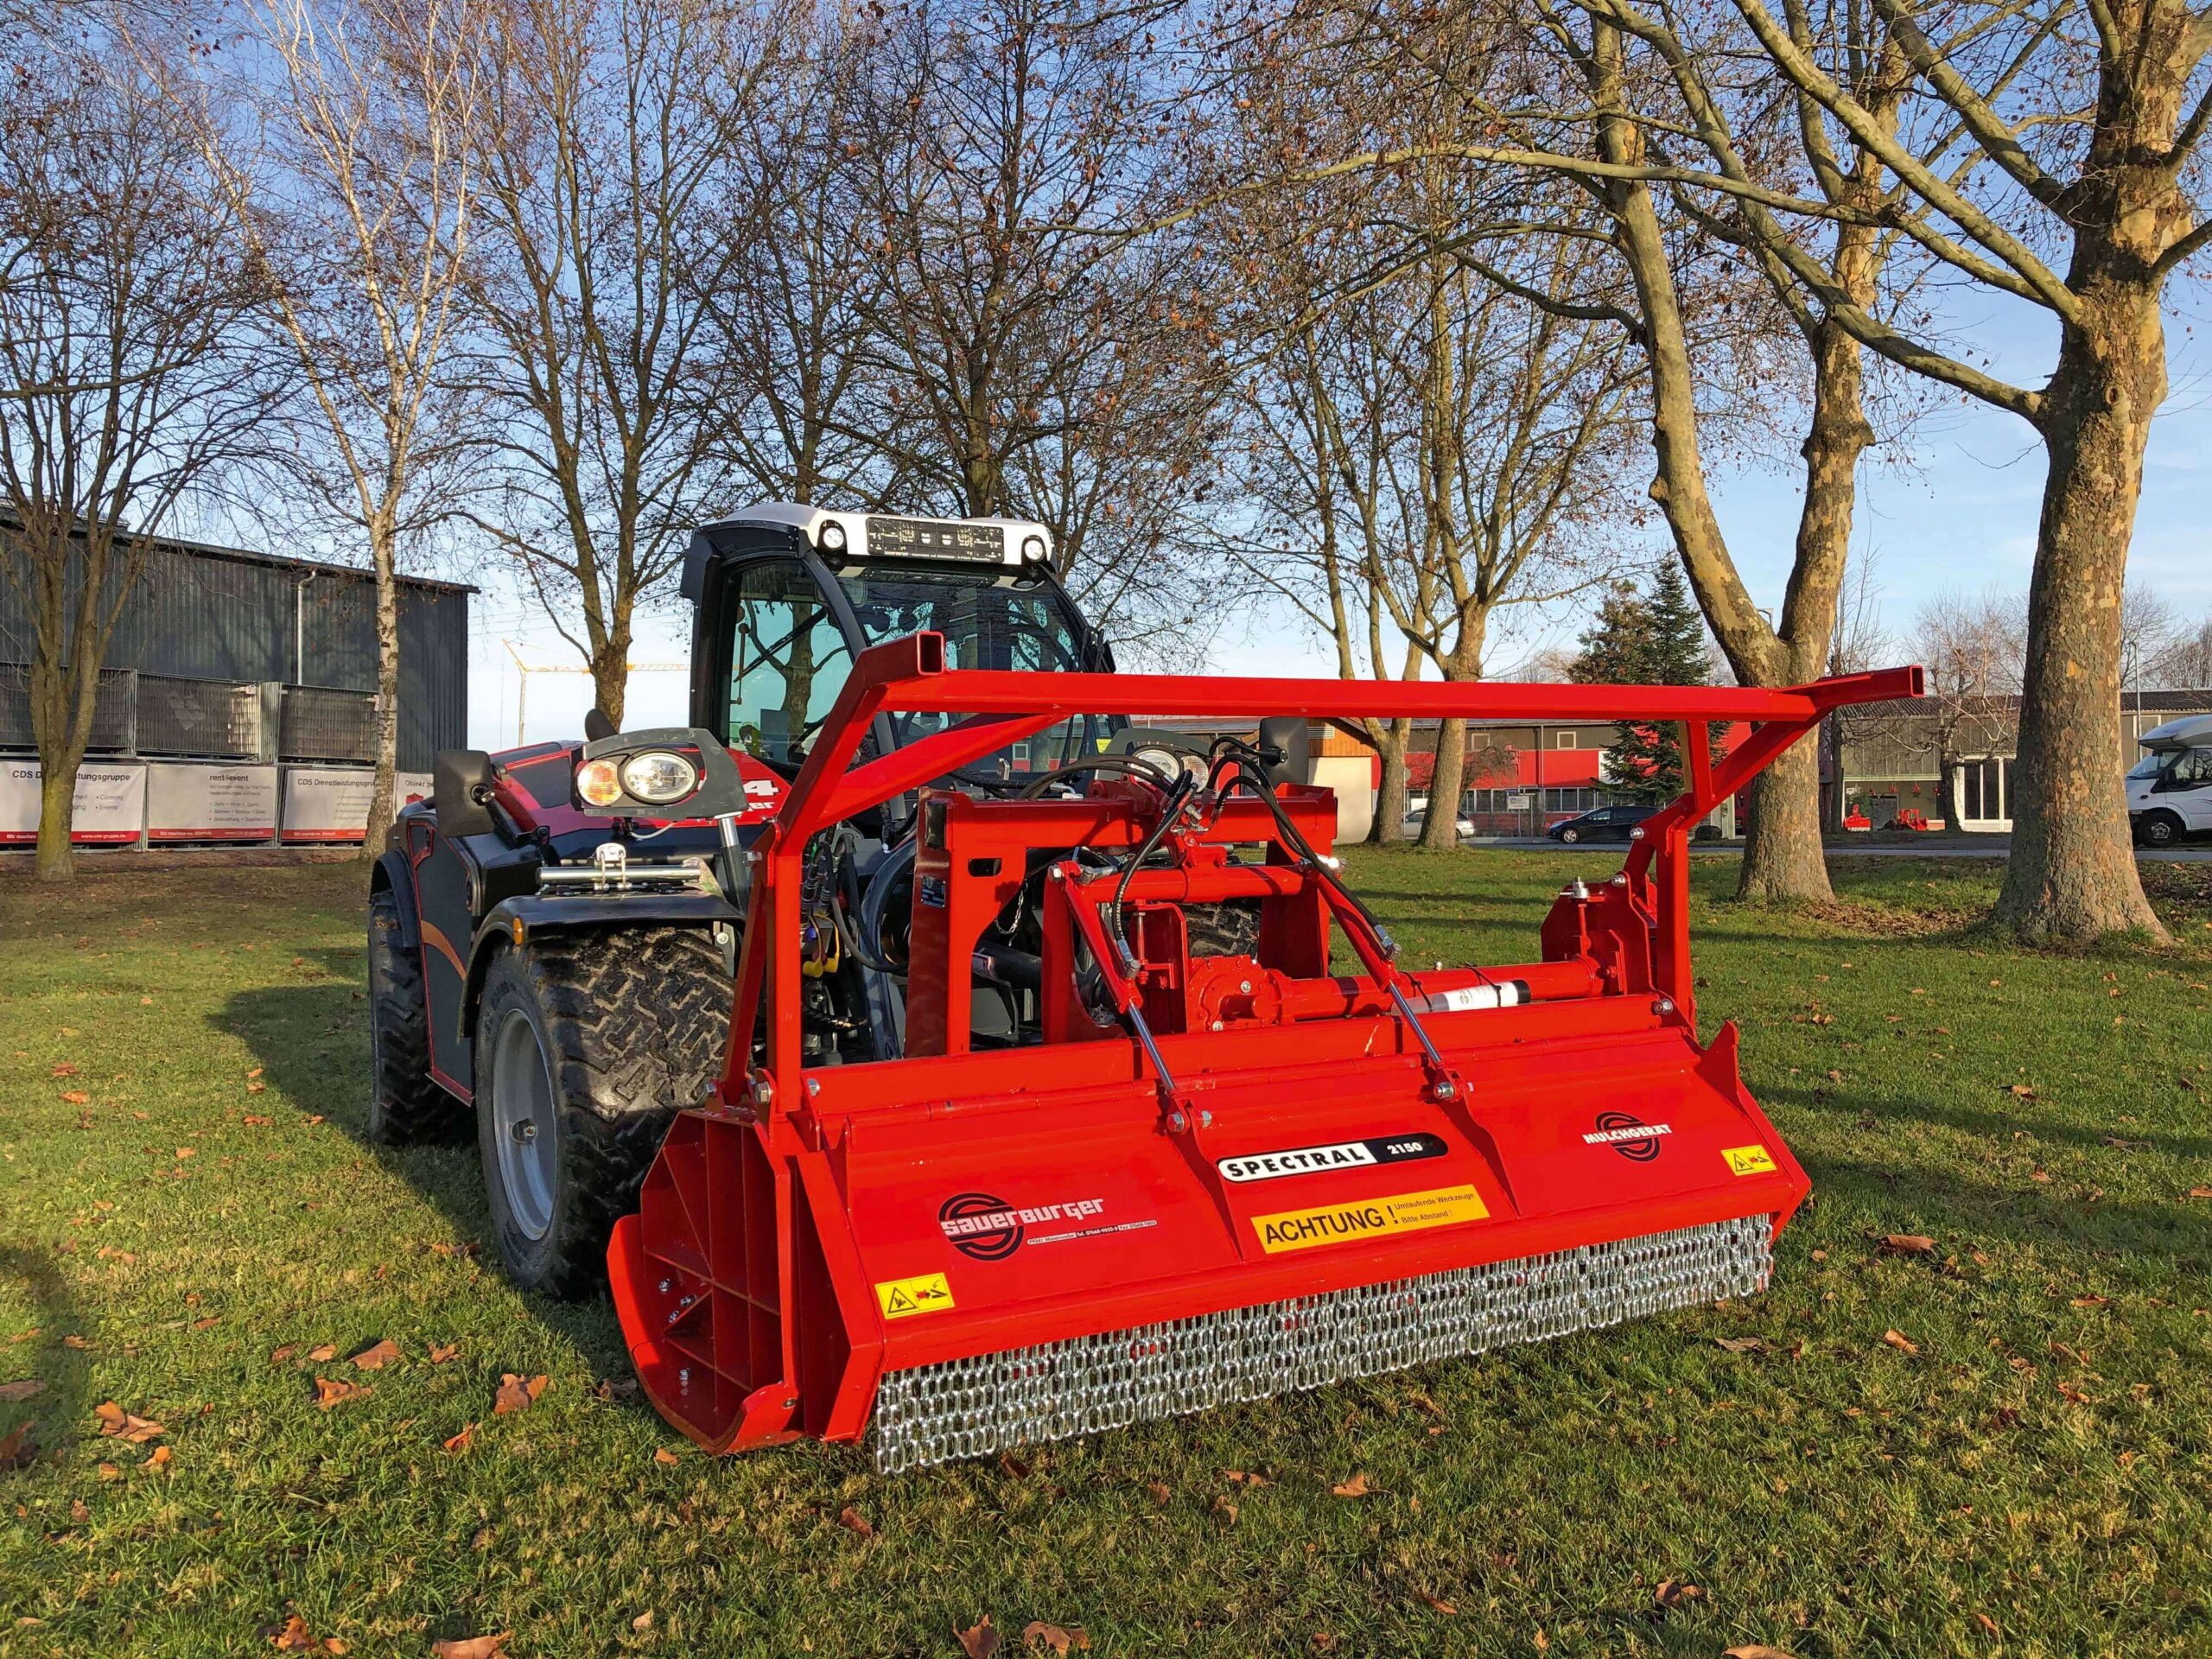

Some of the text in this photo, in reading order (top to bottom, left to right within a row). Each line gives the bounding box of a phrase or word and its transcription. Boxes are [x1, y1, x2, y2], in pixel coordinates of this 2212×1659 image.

[12, 770, 33, 779] CDS
[297, 778, 313, 786] CDS
[1227, 1141, 1423, 1177] SPECTRAL 2150
[1394, 1192, 1475, 1211] Umlaufende Werkzeuge
[1401, 1214, 1419, 1224] Bitte
[1420, 1211, 1448, 1222] Abstand
[1264, 1207, 1384, 1245] ACHTUNG
